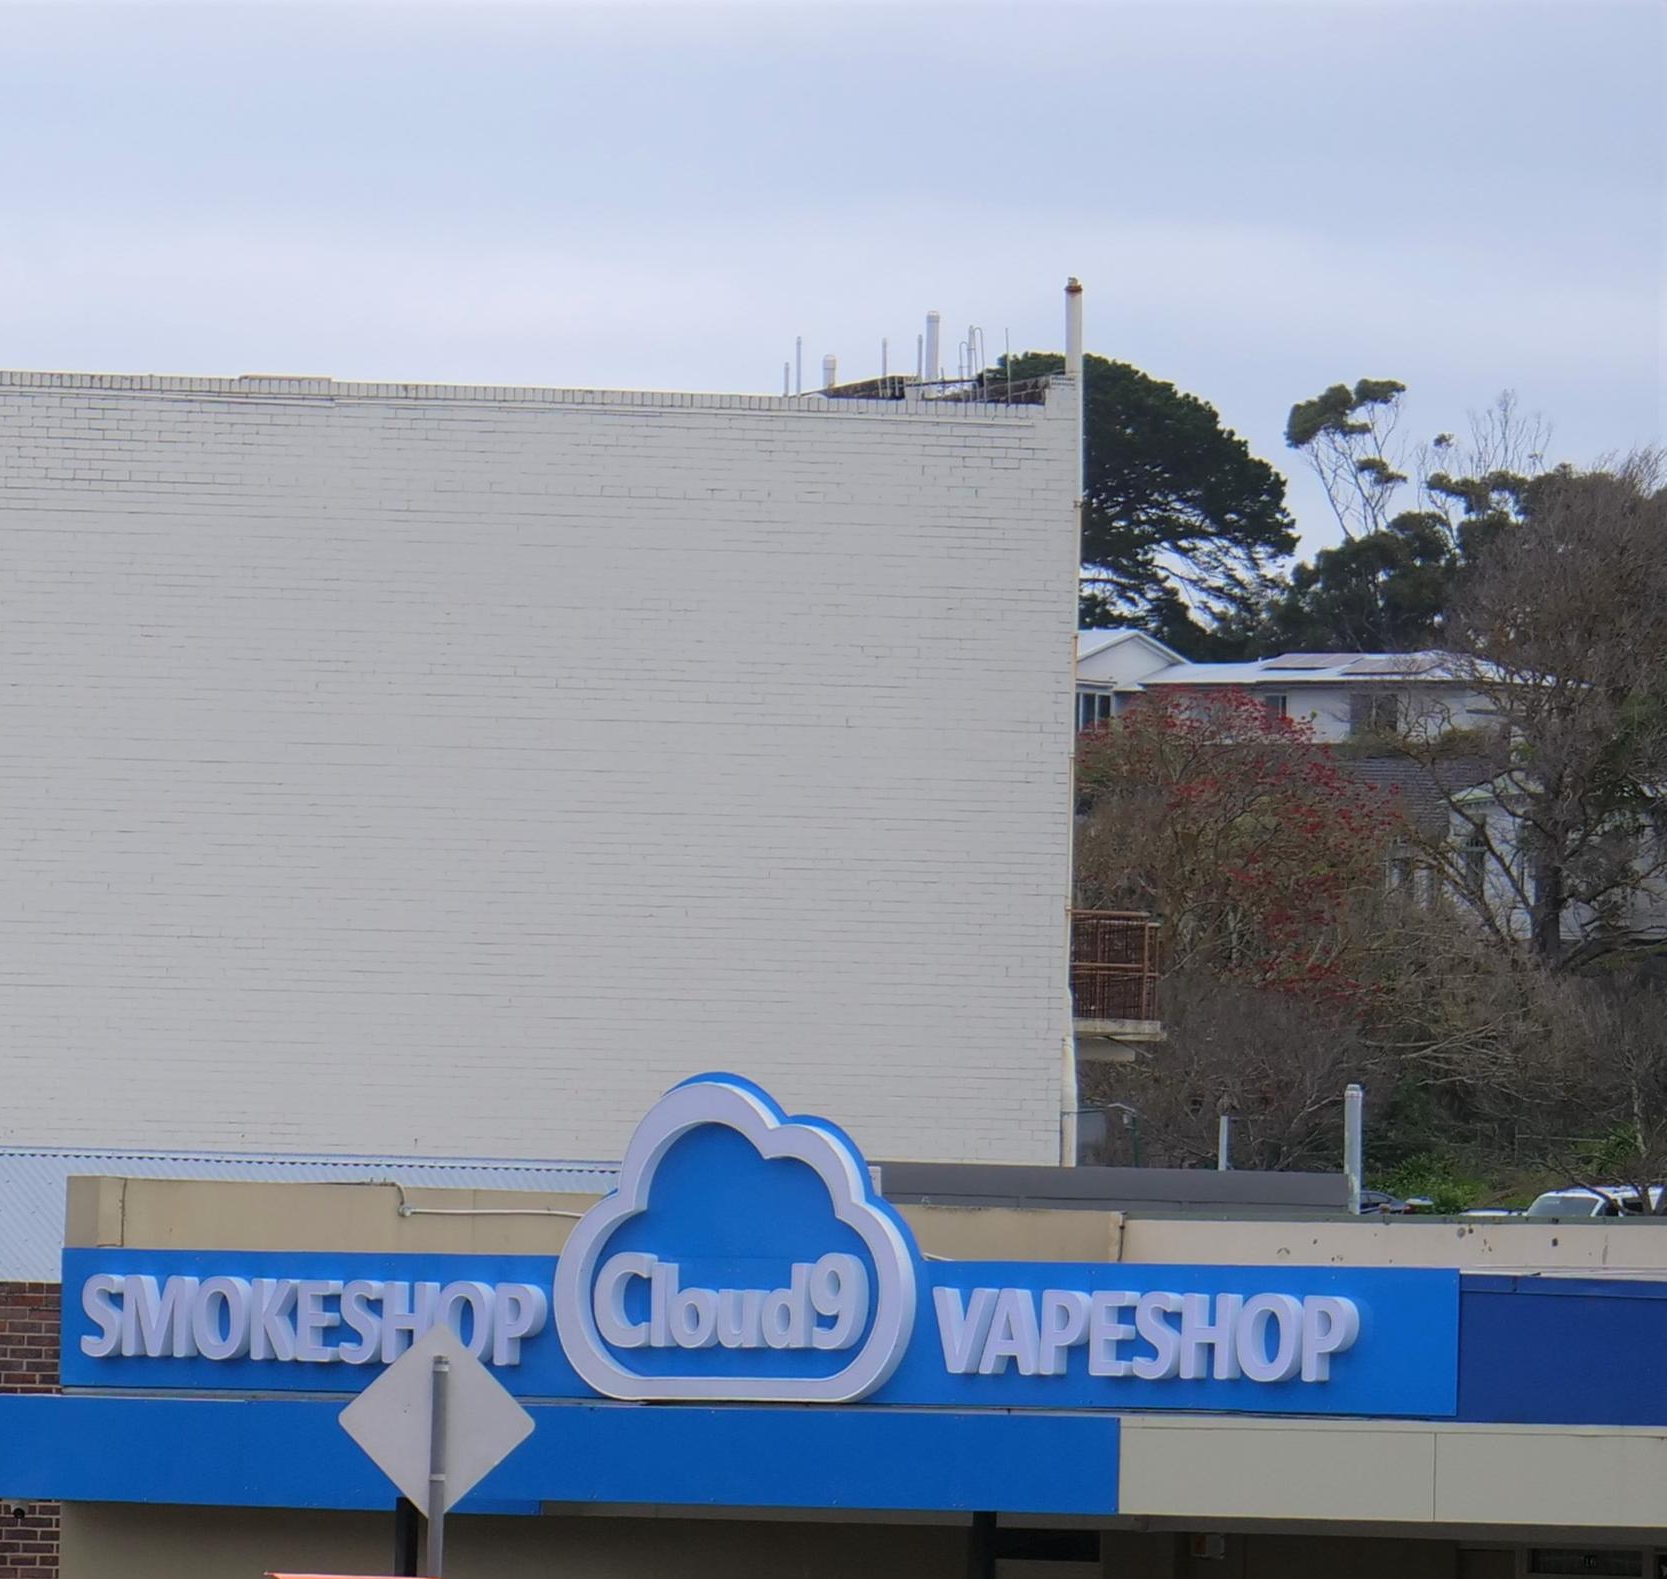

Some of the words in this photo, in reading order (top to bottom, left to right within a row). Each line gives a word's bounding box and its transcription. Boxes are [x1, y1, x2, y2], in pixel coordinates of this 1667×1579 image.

[80, 1273, 547, 1367] SMOKESHOP
[593, 1250, 867, 1350] Cloud9
[933, 1285, 1361, 1384] VAPESHOP
